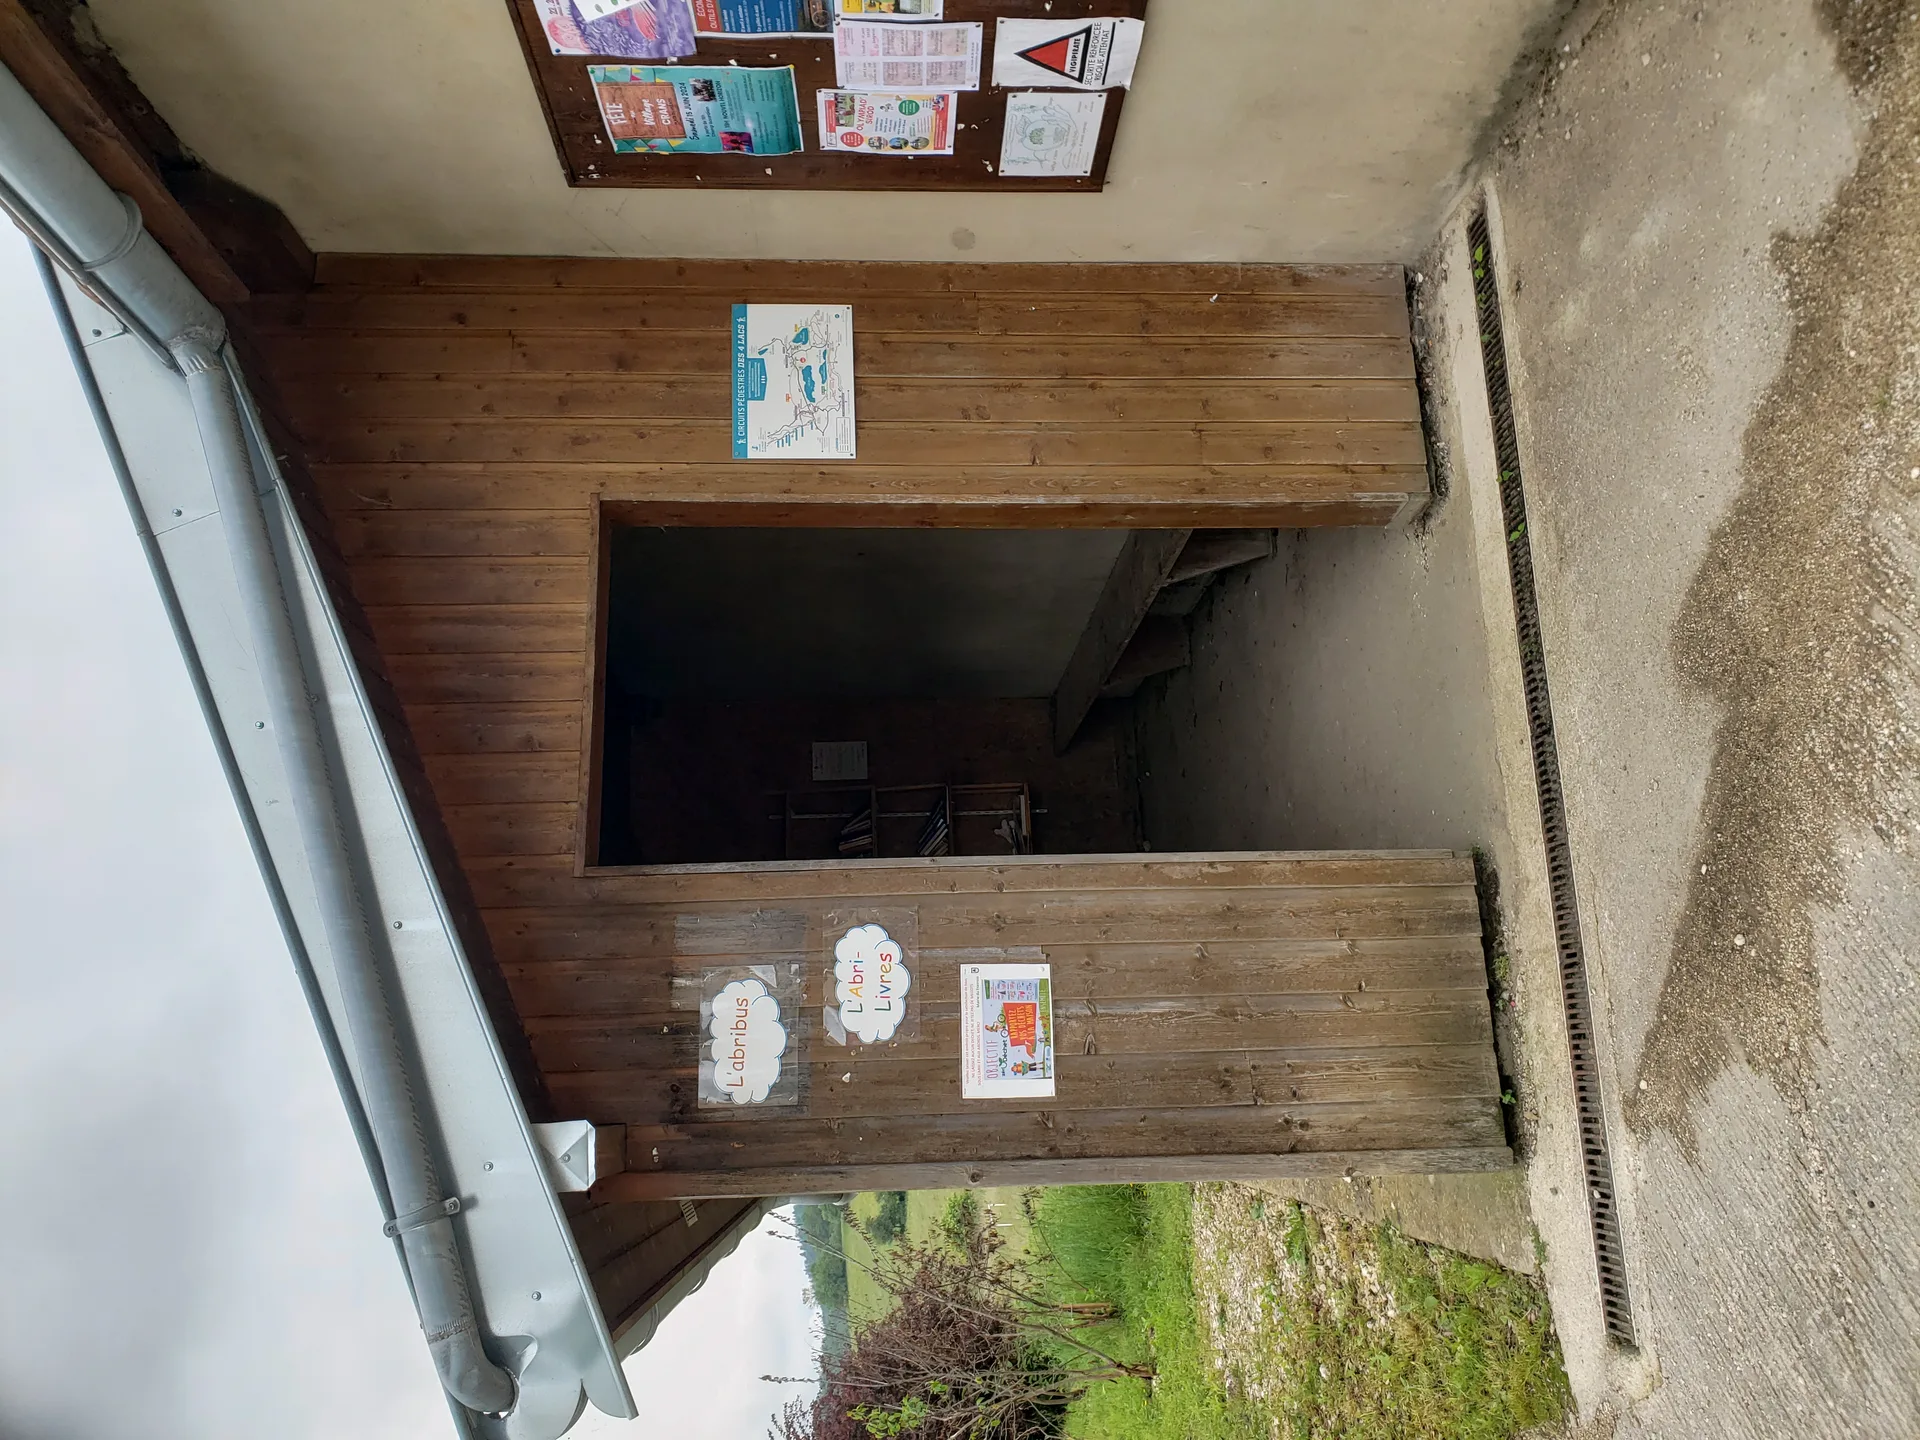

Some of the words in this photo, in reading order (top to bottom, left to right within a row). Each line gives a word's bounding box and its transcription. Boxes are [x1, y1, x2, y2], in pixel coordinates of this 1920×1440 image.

[706, 9, 718, 28] OUTILS
[1089, 22, 1102, 58] RENFORCEE
[1098, 30, 1110, 57] ATTENTAT
[1069, 38, 1080, 73] VIGIPIRATE
[1094, 58, 1104, 80] RISQUE
[1084, 59, 1095, 85] SECURITE
[678, 82, 688, 96] 2024
[715, 80, 724, 101] HORIZON
[604, 102, 628, 125] FÊTE
[641, 98, 656, 126] Village
[656, 98, 671, 125] CRANS
[682, 97, 692, 110] JUIN
[684, 118, 699, 140] Samedi
[736, 370, 745, 406] PÉDESTRES
[737, 408, 745, 436] CIRCUITS
[847, 952, 865, 1013] L'Abri-
[874, 953, 892, 1012] Livres
[1025, 1004, 1034, 1024] MAISON
[726, 997, 749, 1087] L'abribus
[986, 1040, 999, 1079] OBJECTIF
